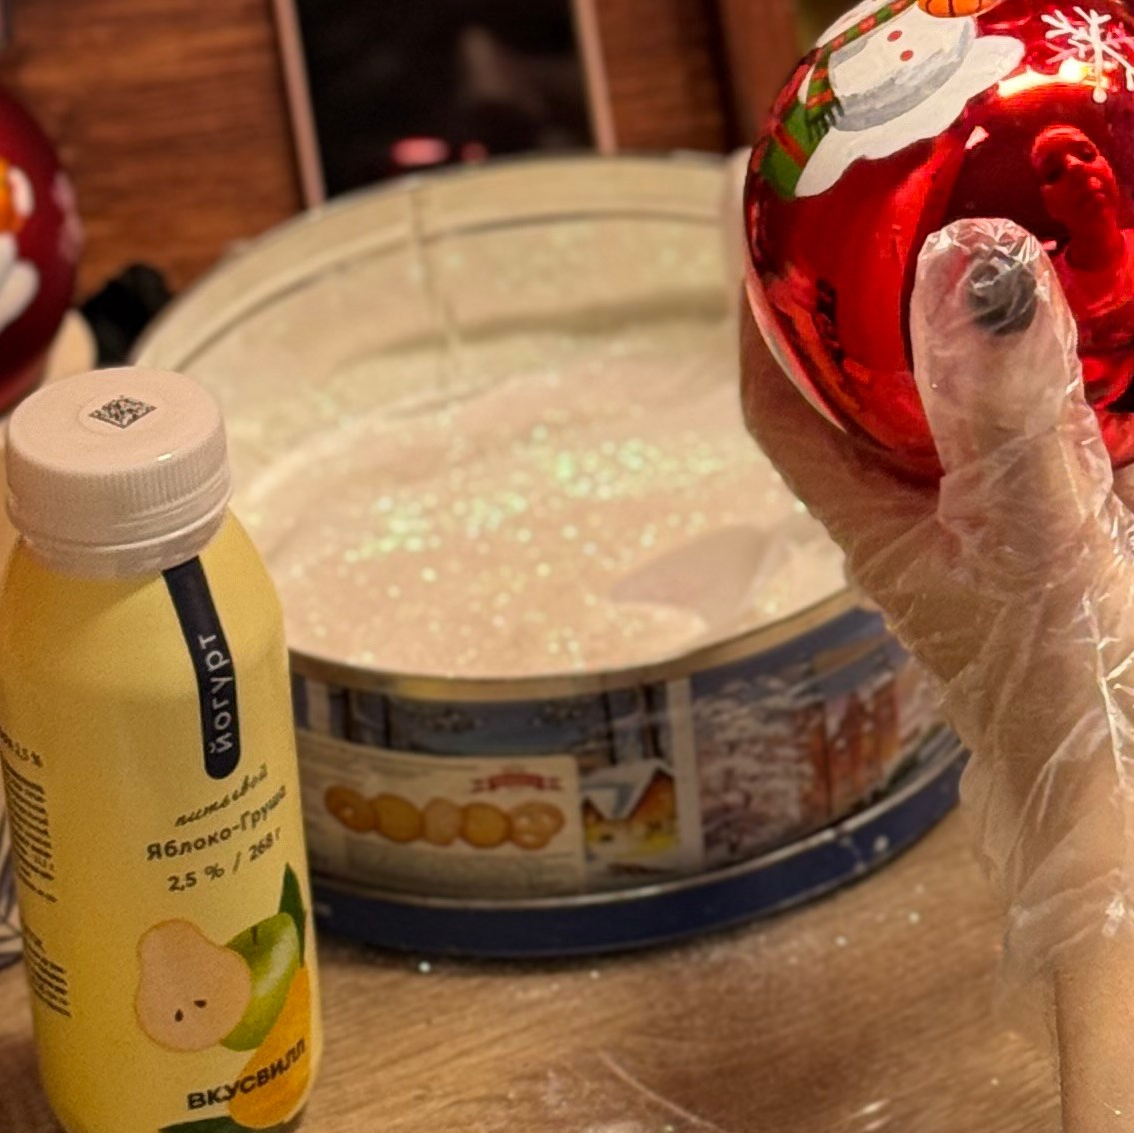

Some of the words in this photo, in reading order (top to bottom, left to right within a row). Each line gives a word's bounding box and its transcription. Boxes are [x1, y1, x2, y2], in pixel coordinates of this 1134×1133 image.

[197, 633, 233, 754] йогурт
[167, 871, 197, 892] 2,5
[204, 863, 225, 880] %
[232, 851, 242, 875] /
[186, 1037, 305, 1110] ВКУСВИЛЛ
